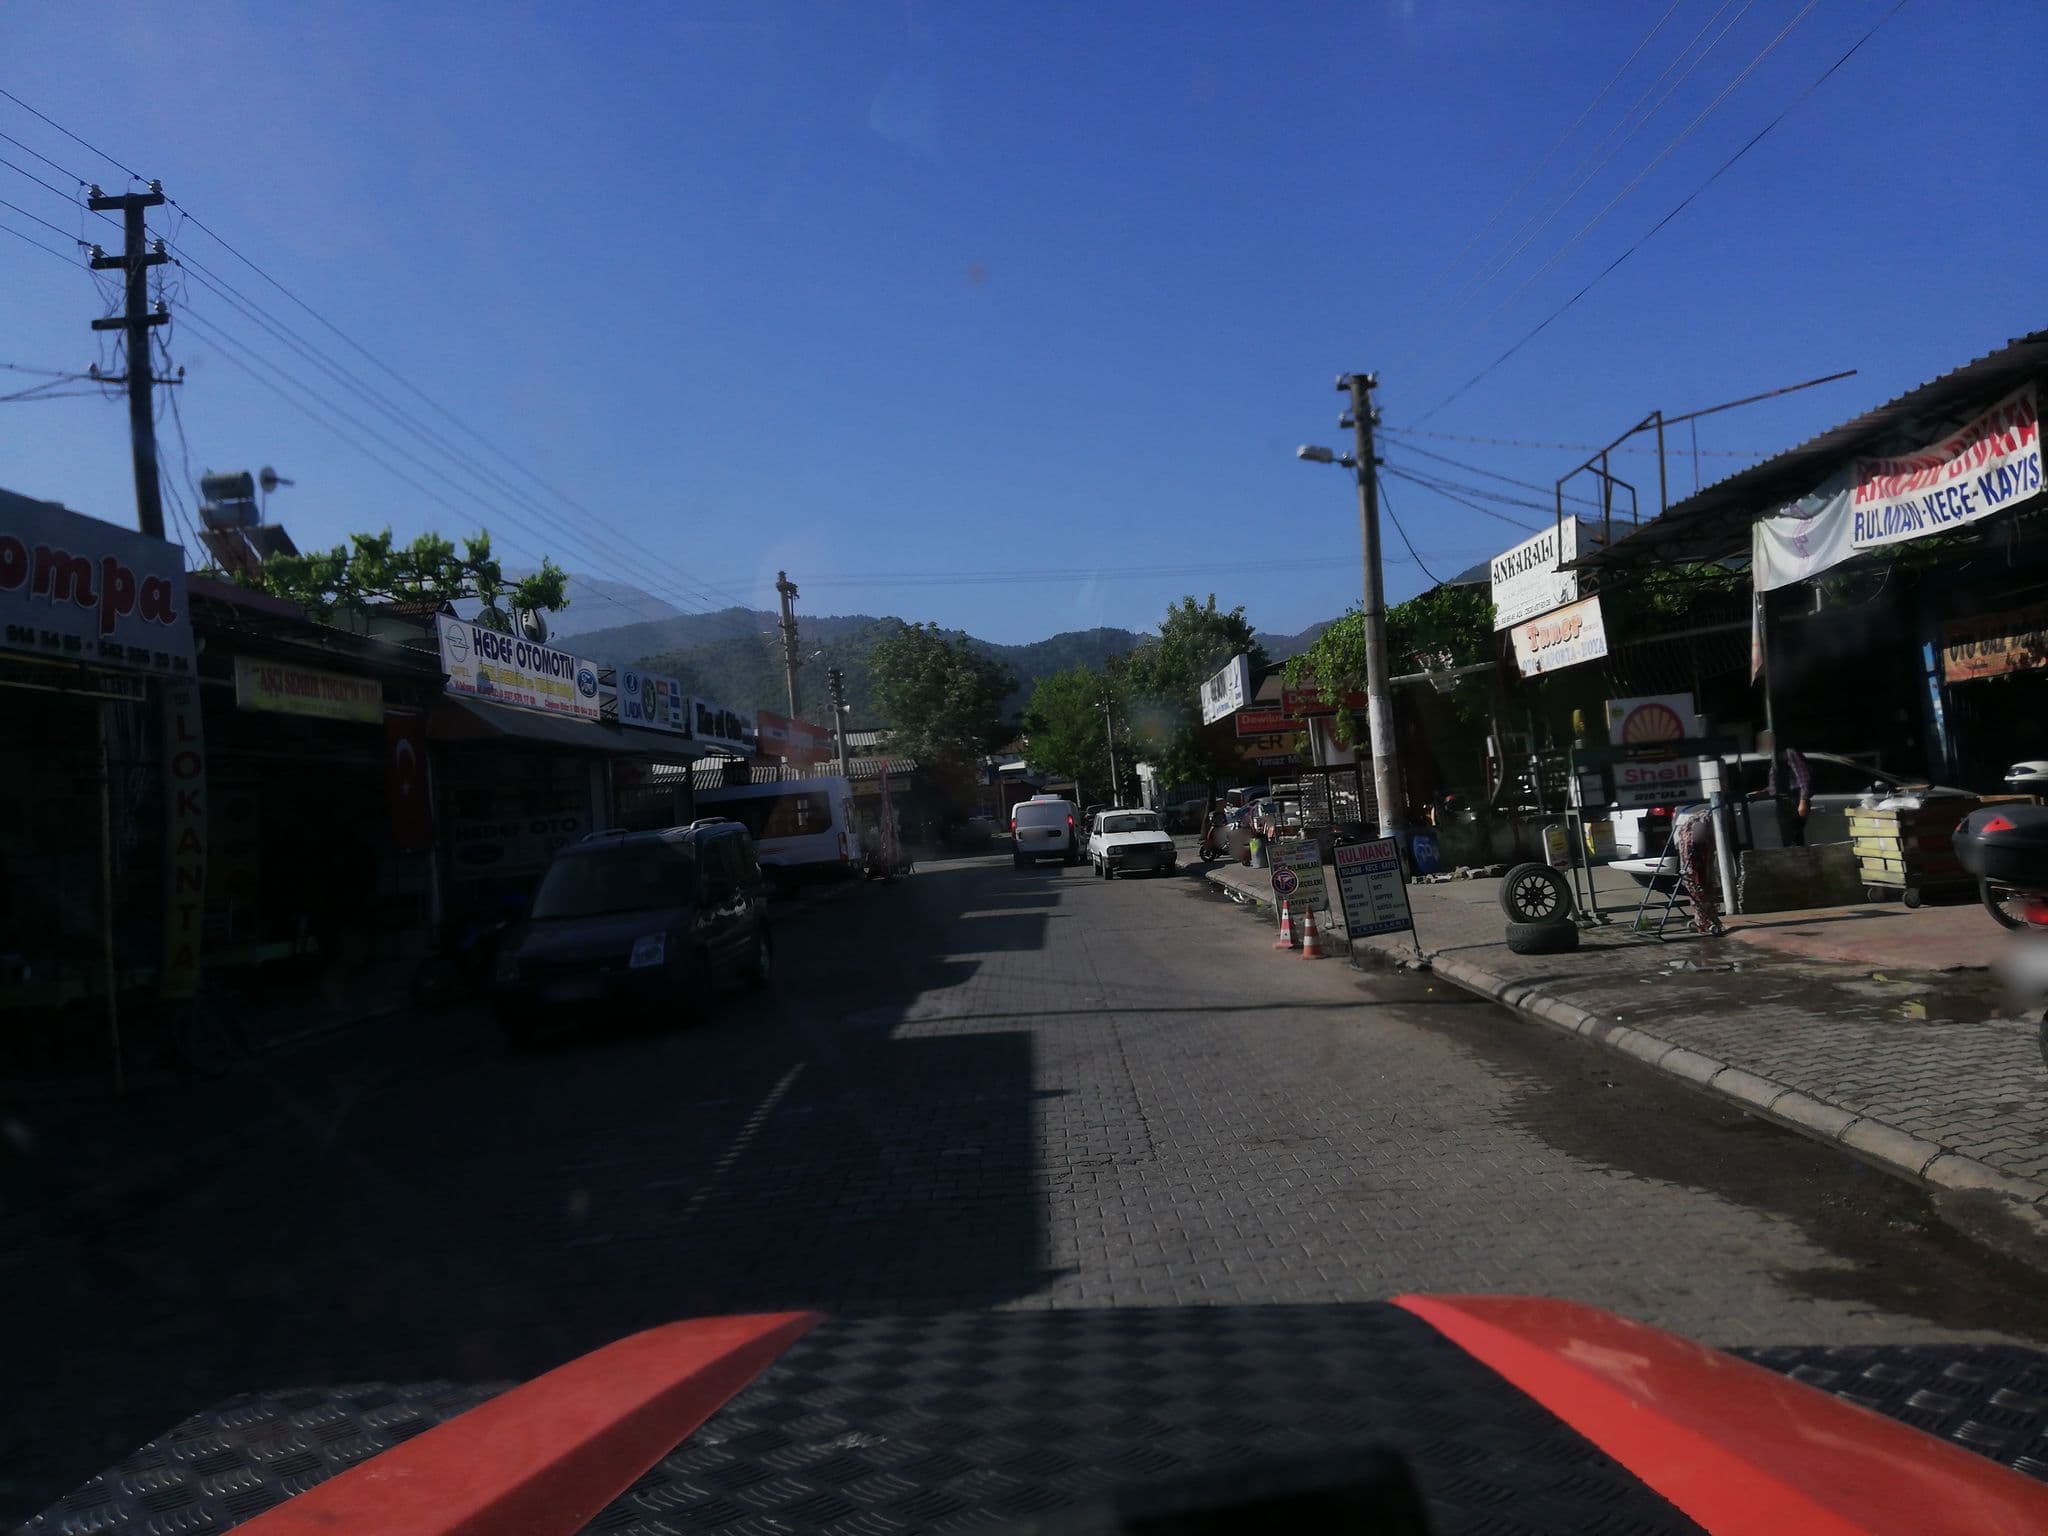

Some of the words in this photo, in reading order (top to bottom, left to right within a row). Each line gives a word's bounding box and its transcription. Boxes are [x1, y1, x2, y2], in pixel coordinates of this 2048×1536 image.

[1493, 535, 1554, 585] ANKARALI
[472, 627, 513, 664] HEDEF
[1624, 764, 1689, 783] Shell
[171, 715, 202, 970] LOKANTA
